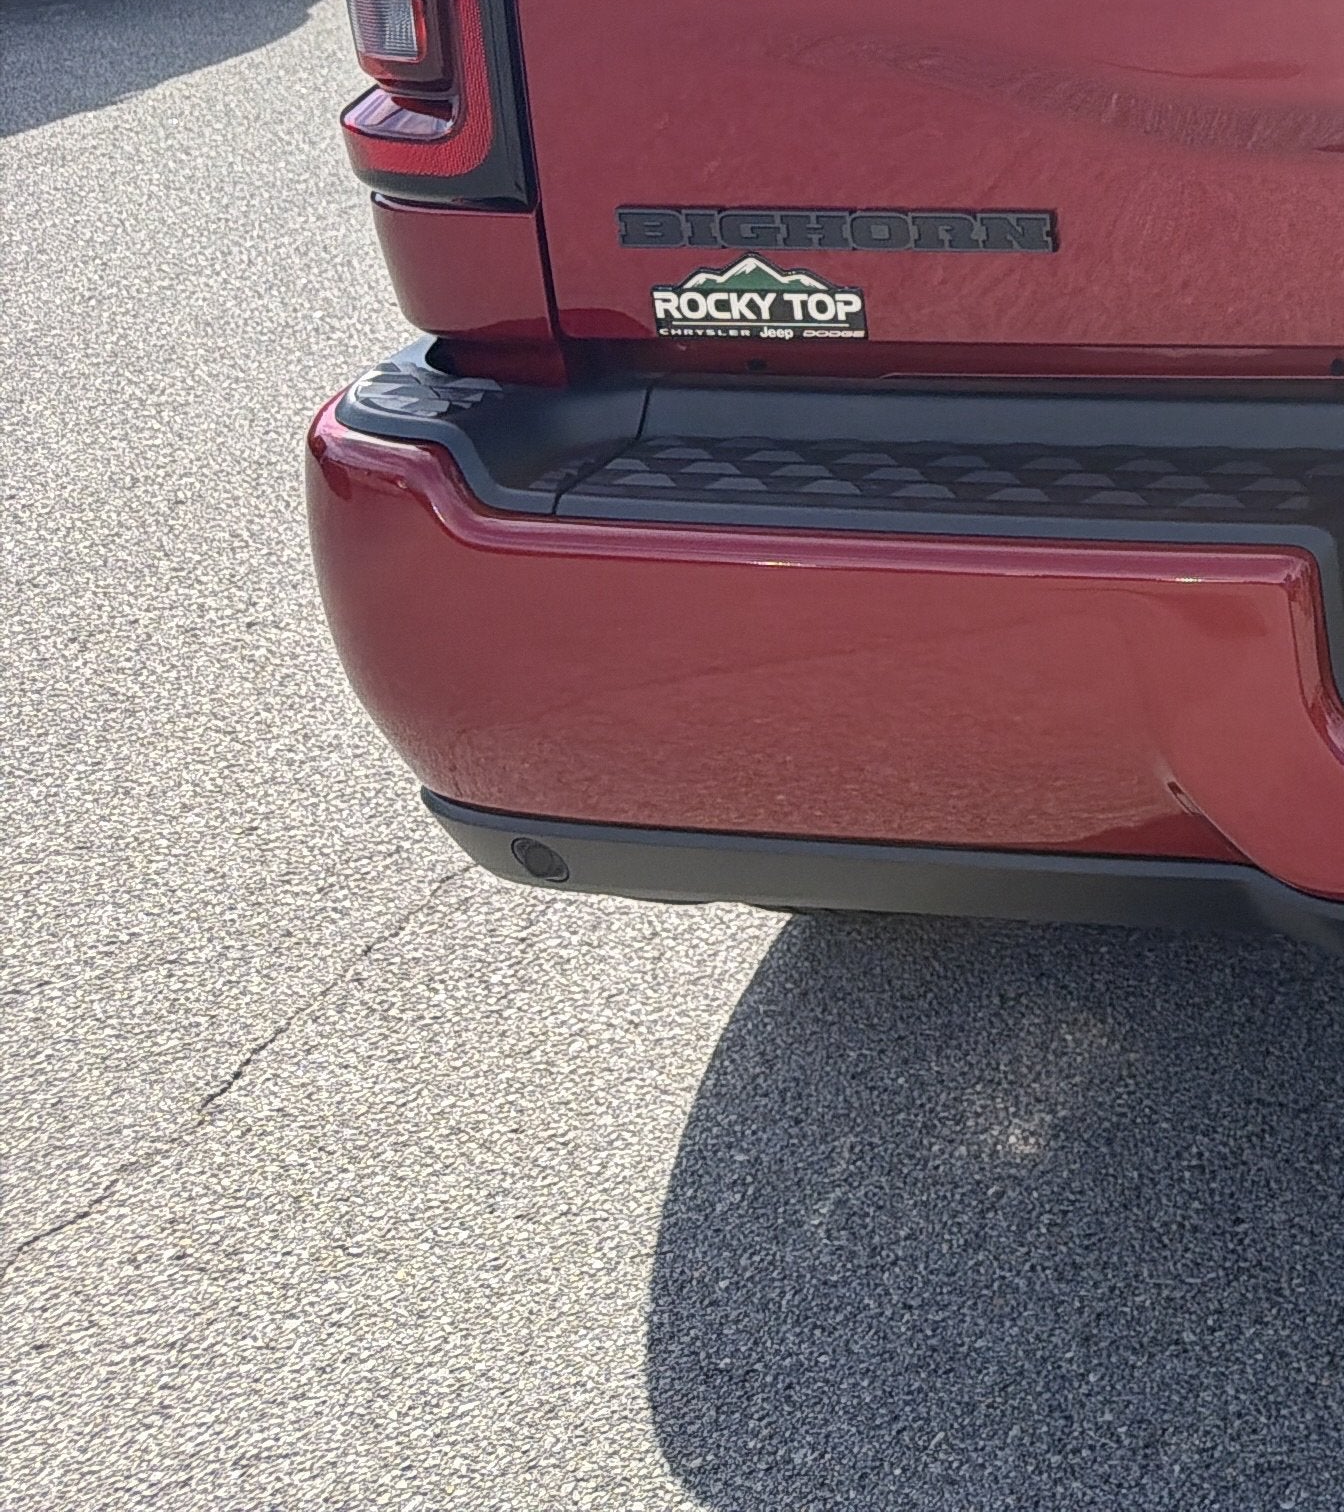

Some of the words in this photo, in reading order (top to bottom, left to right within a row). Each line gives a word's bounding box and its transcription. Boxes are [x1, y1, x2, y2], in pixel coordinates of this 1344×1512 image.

[615, 205, 1060, 253] BIGHORN
[653, 291, 777, 320] ROCKY
[783, 293, 862, 321] TOP
[659, 327, 751, 337] CHRYSLER
[760, 326, 794, 339] Jeep
[803, 329, 866, 338] DODGE
